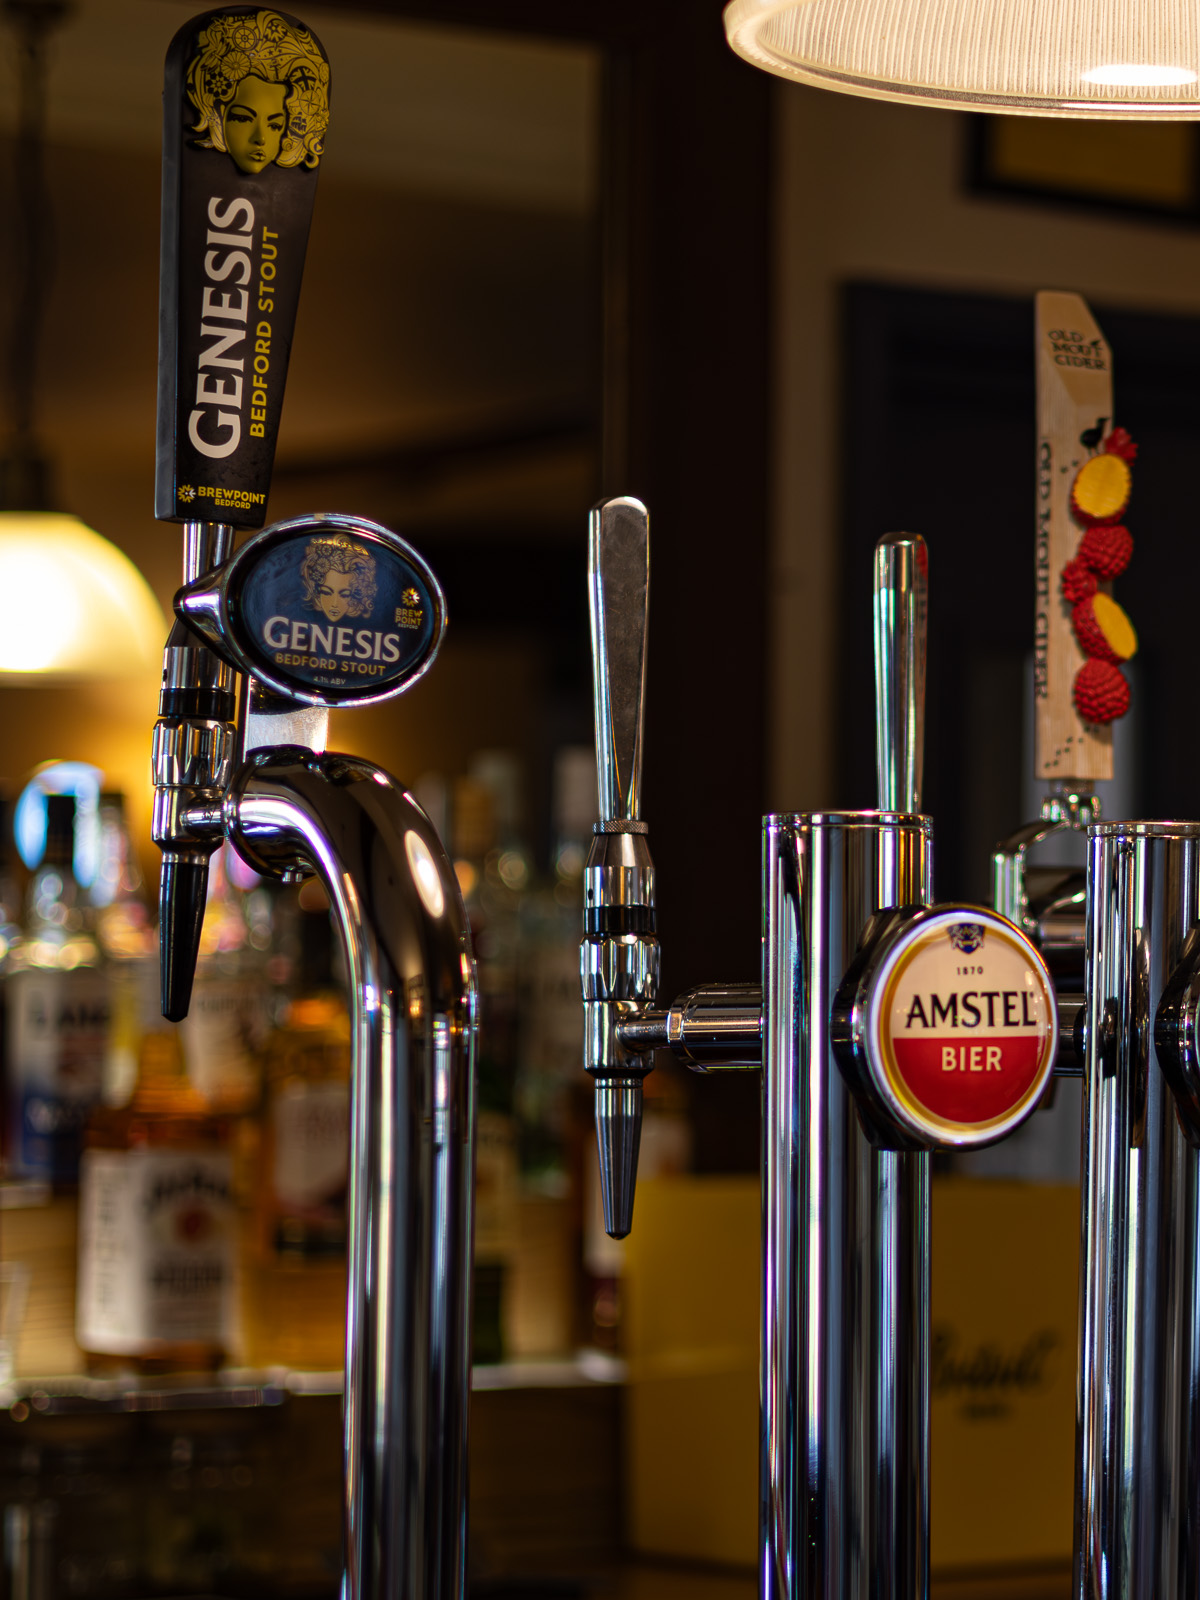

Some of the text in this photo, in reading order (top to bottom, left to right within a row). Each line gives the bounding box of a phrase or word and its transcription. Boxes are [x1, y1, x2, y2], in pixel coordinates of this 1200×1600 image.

[187, 196, 255, 459] GENESIS
[249, 226, 279, 438] BEDFORD STOUT
[1048, 329, 1083, 342] OLD
[1054, 354, 1107, 370] CIDER
[198, 486, 265, 504] BREWPOINT
[215, 498, 251, 509] BEDFORD
[1035, 442, 1055, 700] OLD MOUT CIDER
[395, 607, 423, 618] BREW
[395, 616, 422, 626] POINT
[263, 616, 400, 662] GENESIS
[275, 653, 386, 676] BEDFORD STOUT
[330, 677, 346, 685] ABV
[956, 966, 984, 975] 1870
[905, 991, 1037, 1029] AMSTEL
[941, 1046, 1003, 1072] BIER
